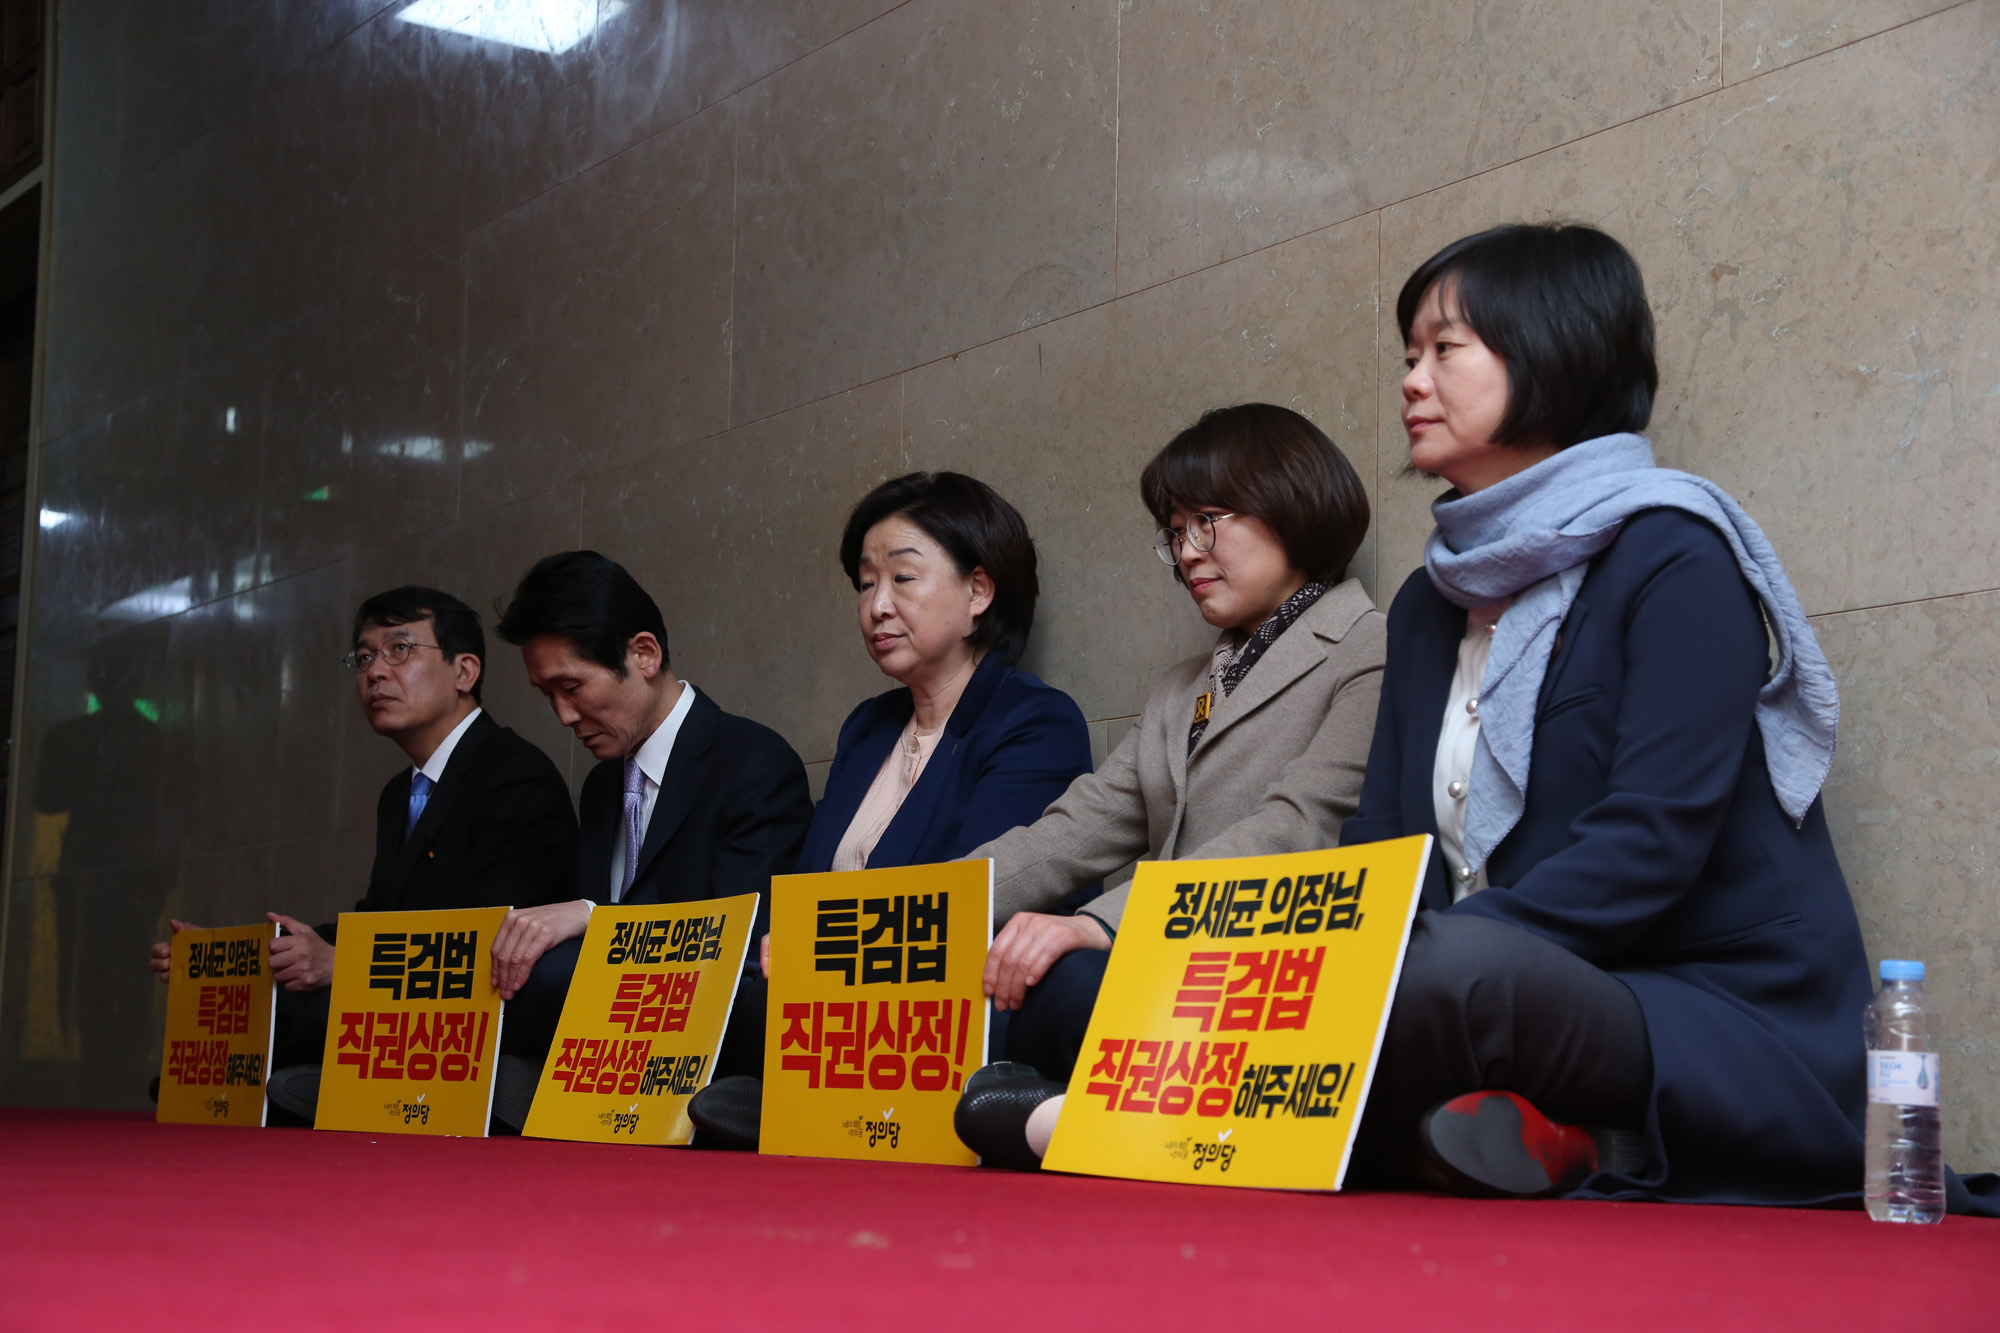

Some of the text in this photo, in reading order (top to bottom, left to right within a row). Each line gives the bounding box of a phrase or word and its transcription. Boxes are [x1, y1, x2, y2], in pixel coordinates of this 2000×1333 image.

[1164, 868, 1368, 940] 정세균 의장님,
[188, 940, 227, 979] 정세균
[369, 930, 478, 1000] 특검법
[606, 919, 672, 965] 정세균
[814, 892, 949, 987] 특검법
[198, 983, 251, 1035] 특검법
[608, 970, 701, 1034] 특검법
[1172, 946, 1327, 1032] 특검법
[337, 1010, 489, 1082] 직권상정!
[780, 998, 971, 1092] 직권상정!
[213, 1100, 230, 1118] 정의당
[402, 1103, 430, 1126] 정의당
[613, 1113, 640, 1135] 정의당
[865, 1121, 901, 1149] 정의당
[1192, 1143, 1236, 1172] 정의당
